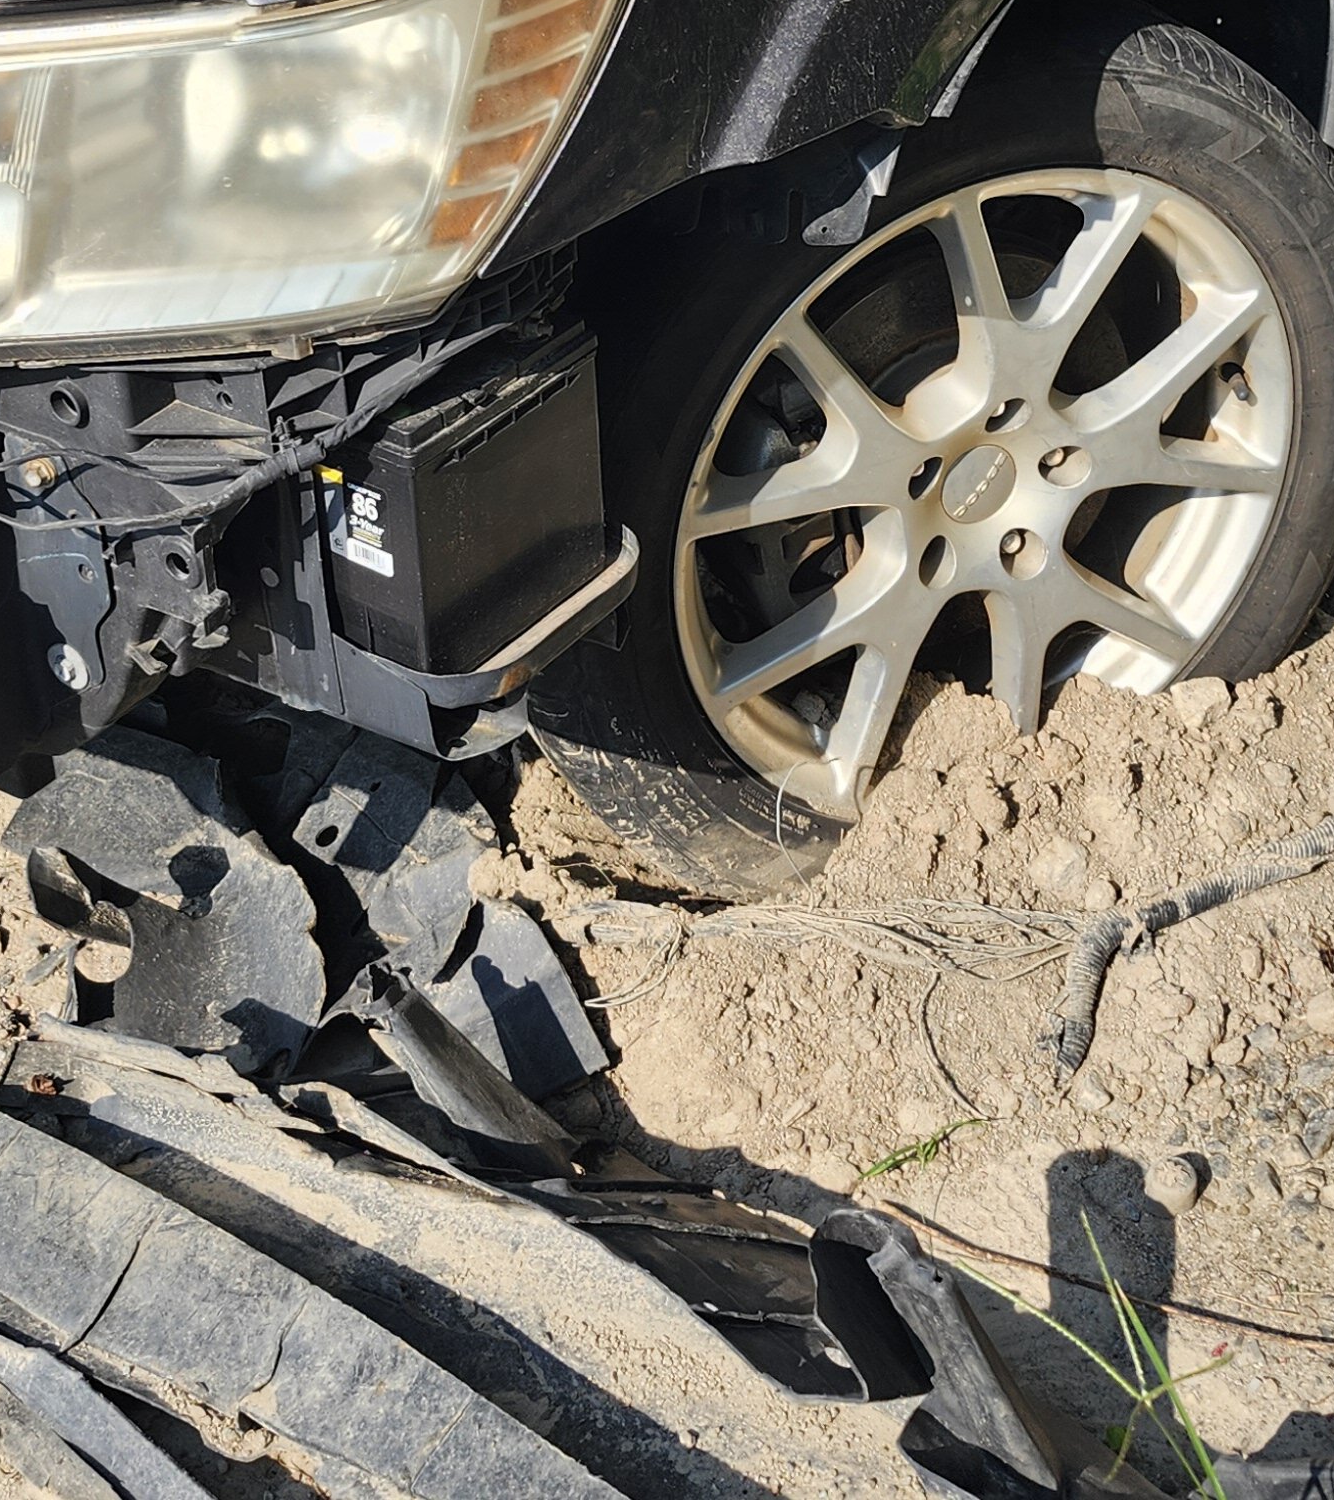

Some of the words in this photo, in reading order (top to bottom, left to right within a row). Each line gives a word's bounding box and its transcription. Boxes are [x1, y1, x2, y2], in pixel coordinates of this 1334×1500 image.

[953, 452, 1008, 519] DODGE
[352, 492, 379, 521] 86
[349, 514, 385, 536] 3-Year
